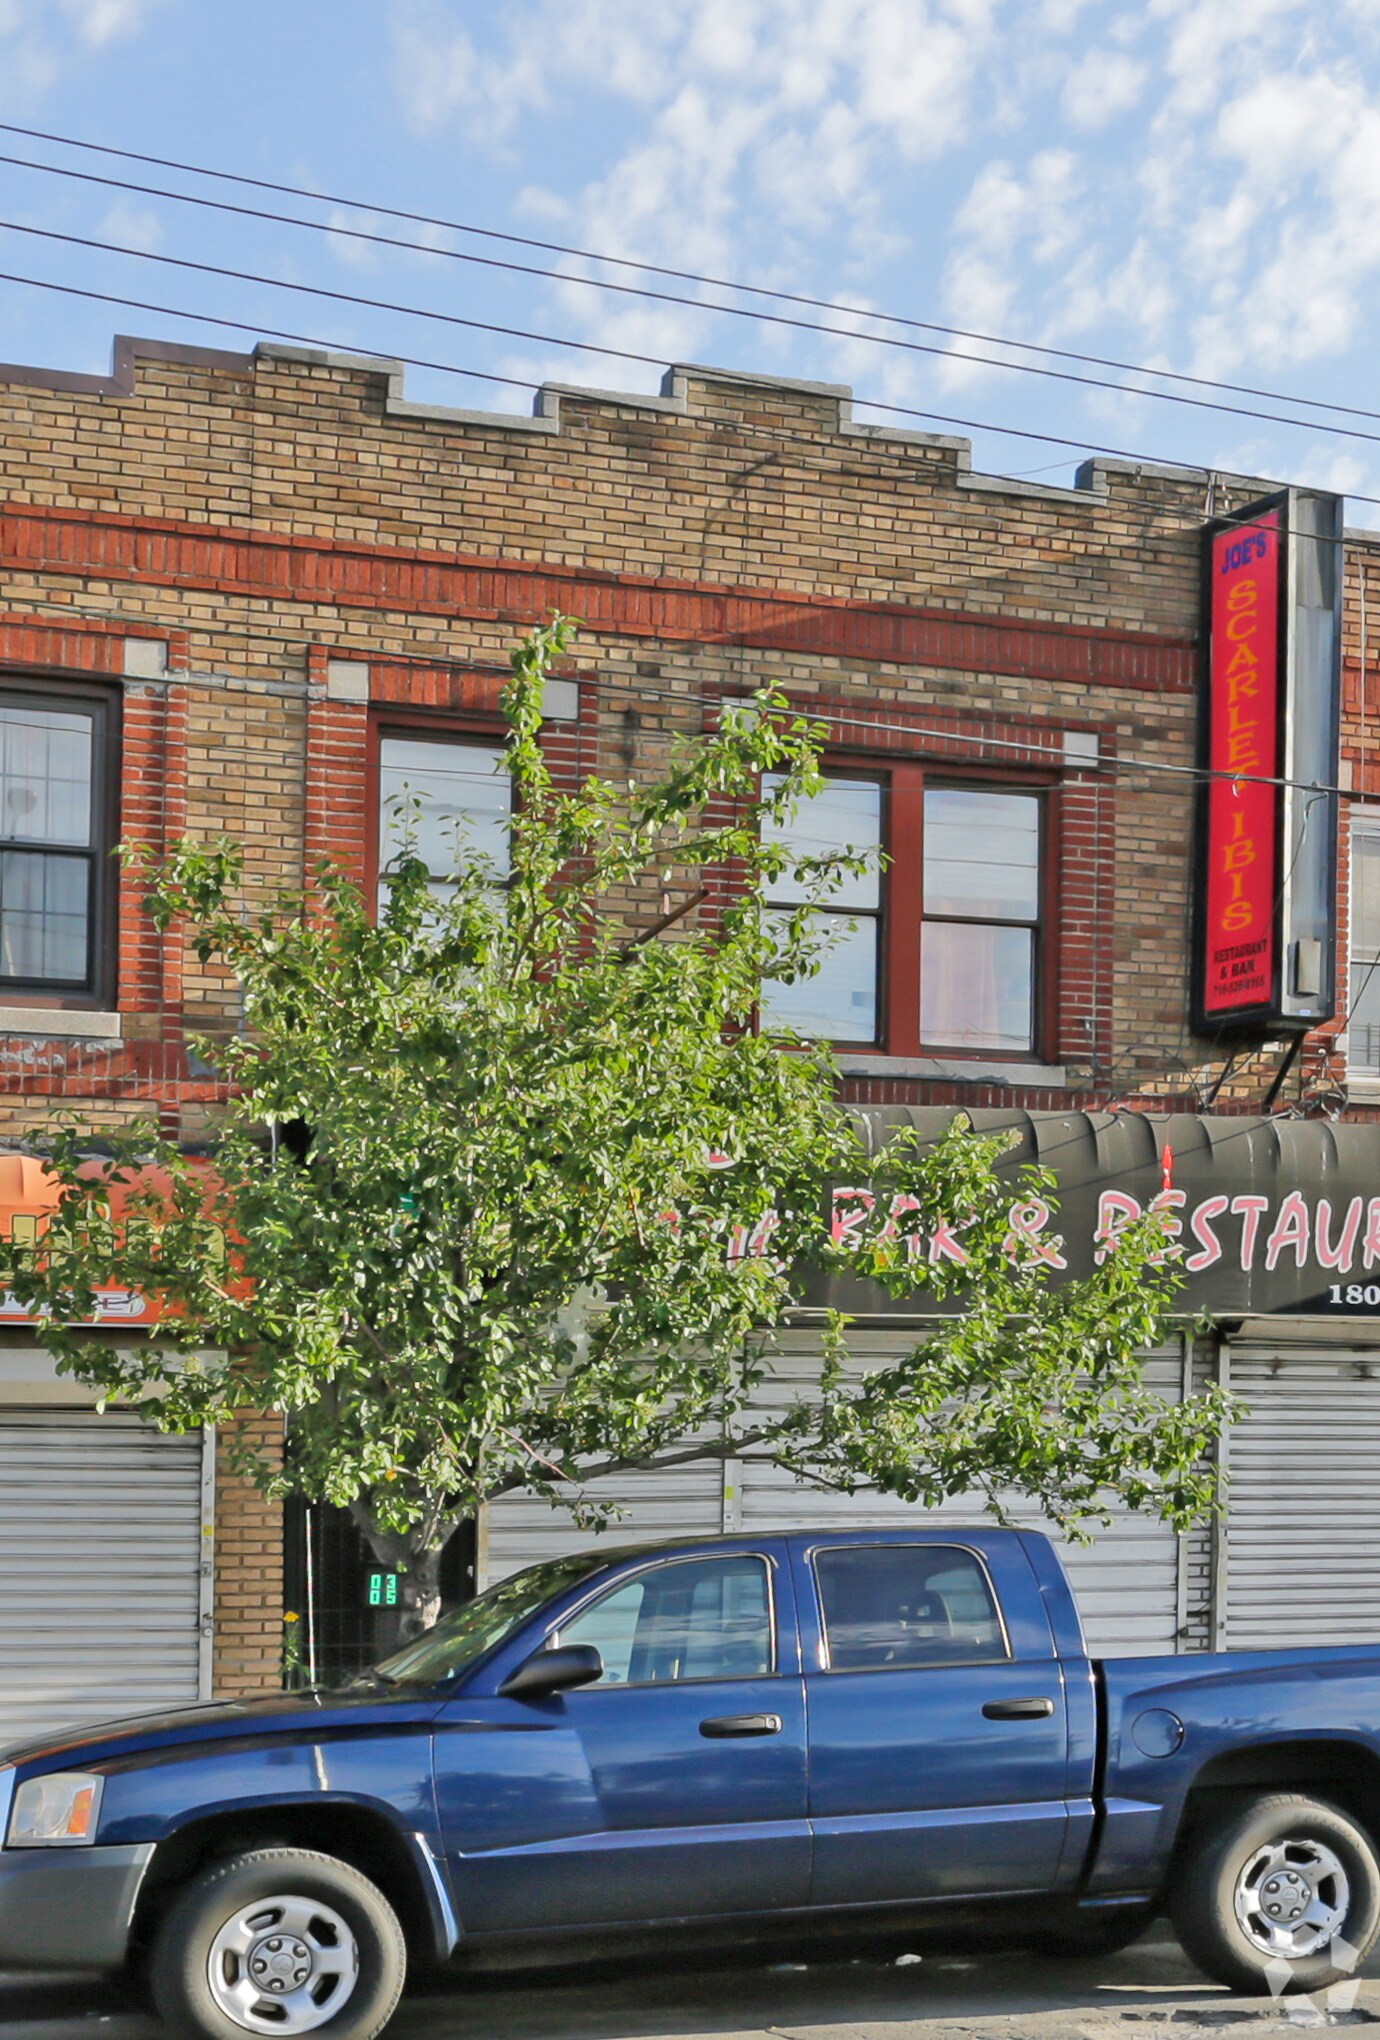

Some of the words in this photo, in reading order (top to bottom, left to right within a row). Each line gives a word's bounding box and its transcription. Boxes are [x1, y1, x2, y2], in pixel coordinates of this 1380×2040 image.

[1220, 531, 1267, 575] JOE'S
[1223, 579, 1260, 793] SCARLET
[1220, 811, 1257, 932] IBIS
[1213, 939, 1267, 964] RESTAURANT
[1220, 966, 1228, 980] &
[1231, 960, 1256, 977] BAR
[1002, 1197, 1068, 1269] &
